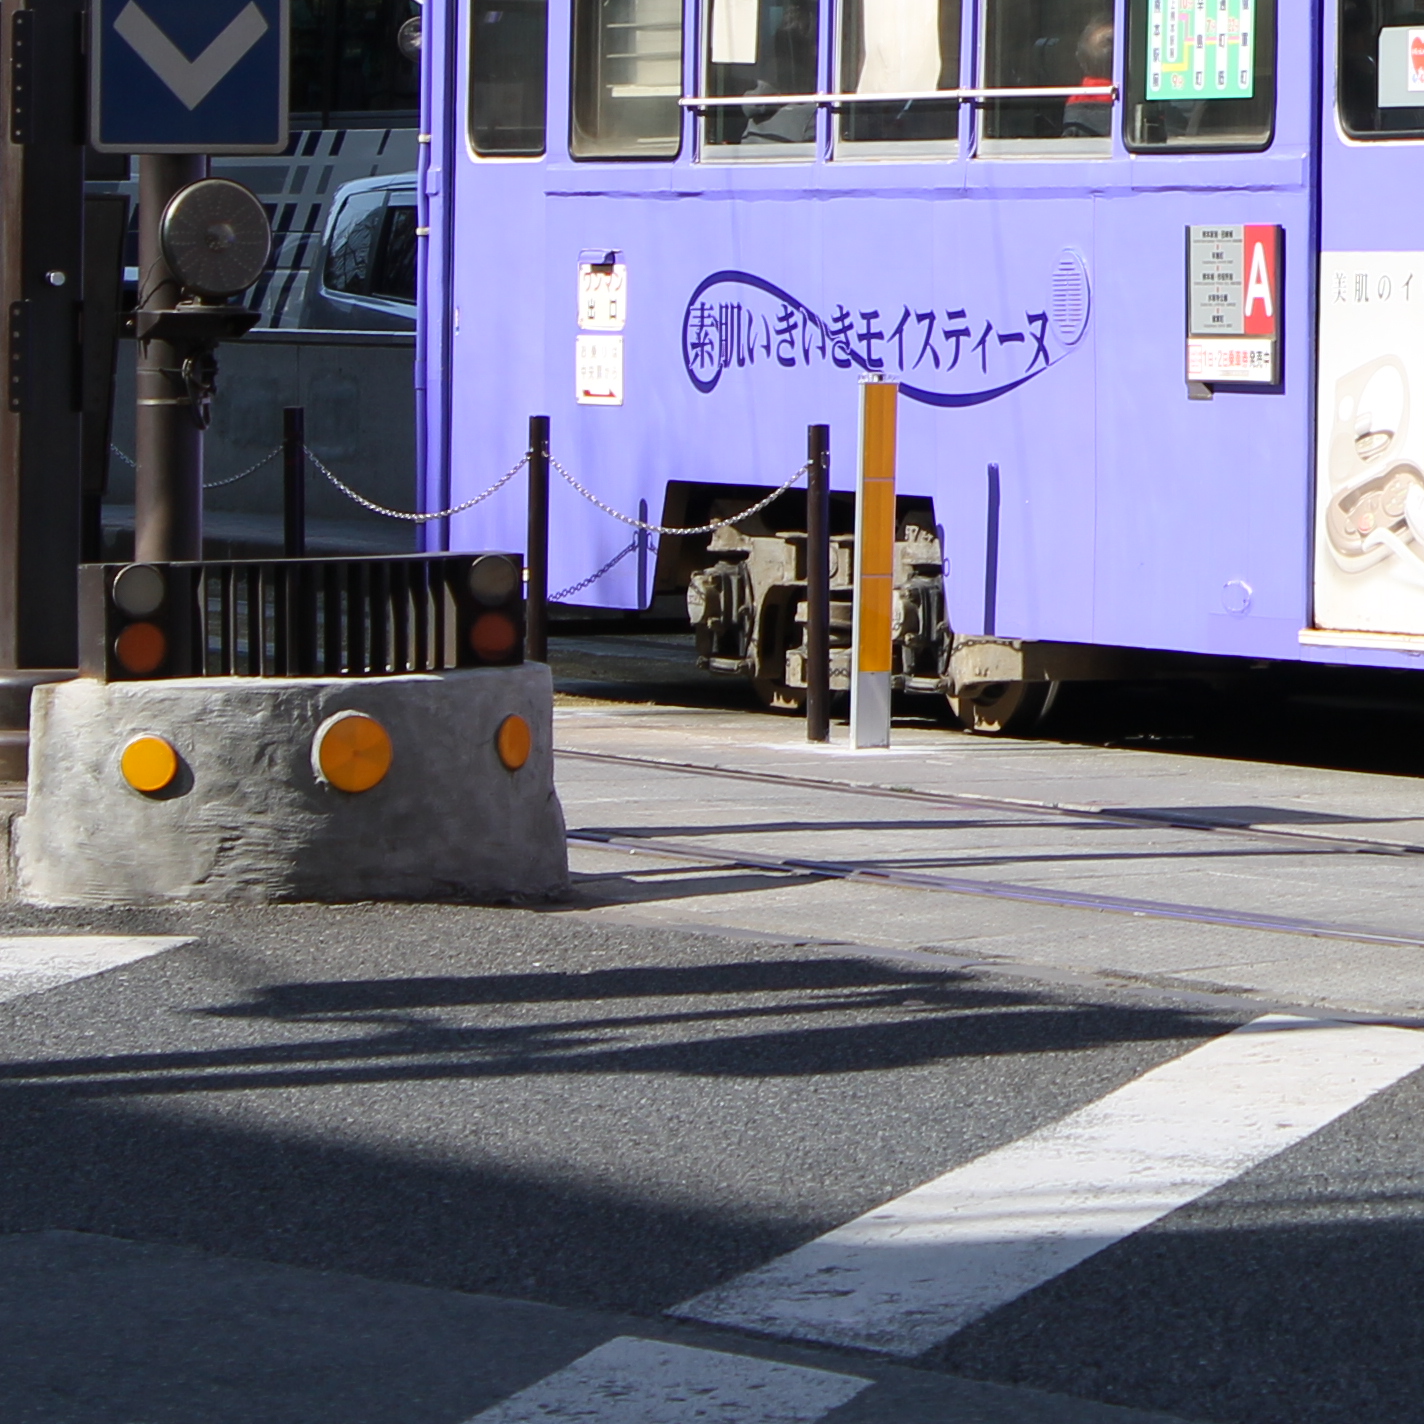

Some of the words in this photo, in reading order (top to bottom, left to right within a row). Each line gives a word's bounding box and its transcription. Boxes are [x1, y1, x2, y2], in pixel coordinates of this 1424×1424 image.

[583, 272, 623, 293] ワンマン
[1244, 241, 1273, 318] A
[587, 298, 617, 321] 出口
[688, 302, 1051, 374] 素肌いきいきモイスティーヌ
